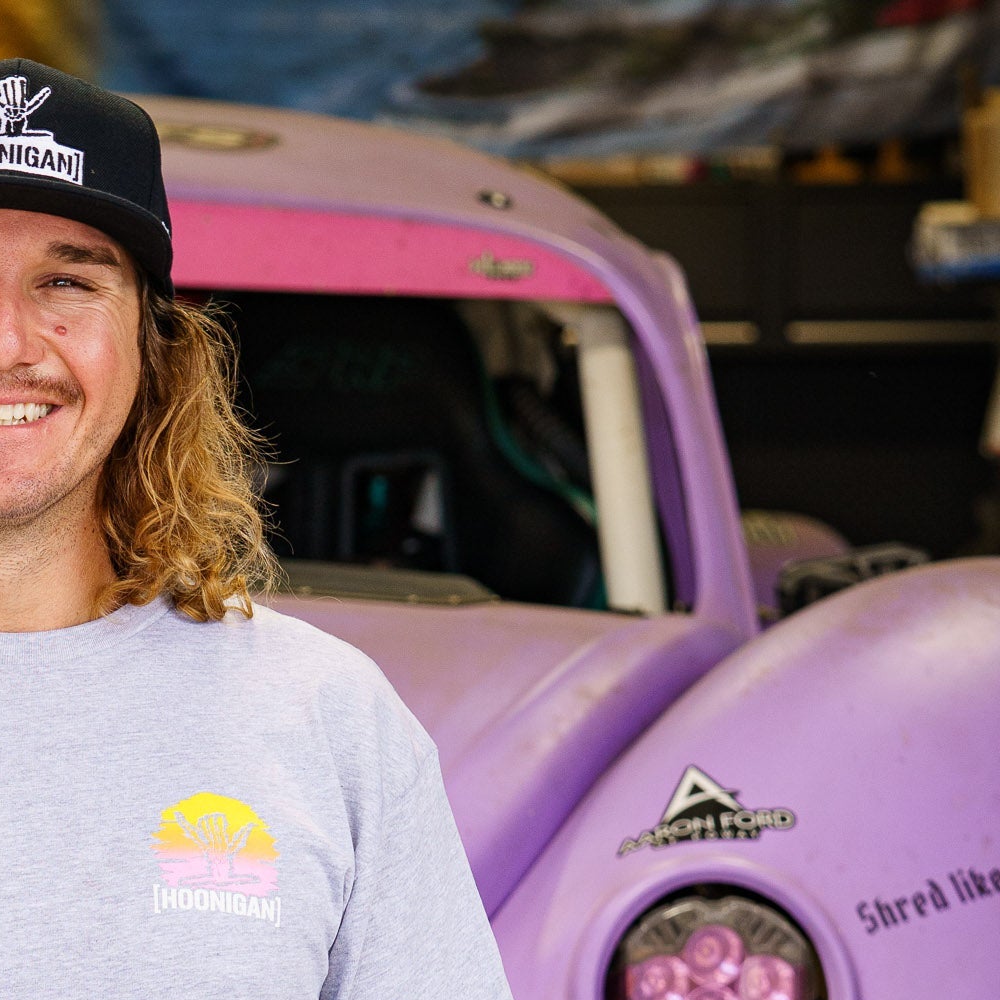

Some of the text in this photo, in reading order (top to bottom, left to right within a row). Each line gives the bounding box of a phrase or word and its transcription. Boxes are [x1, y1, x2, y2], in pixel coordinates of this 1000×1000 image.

[617, 814, 716, 858] AARON
[719, 808, 796, 832] FORD
[856, 867, 1000, 934] Shred like
